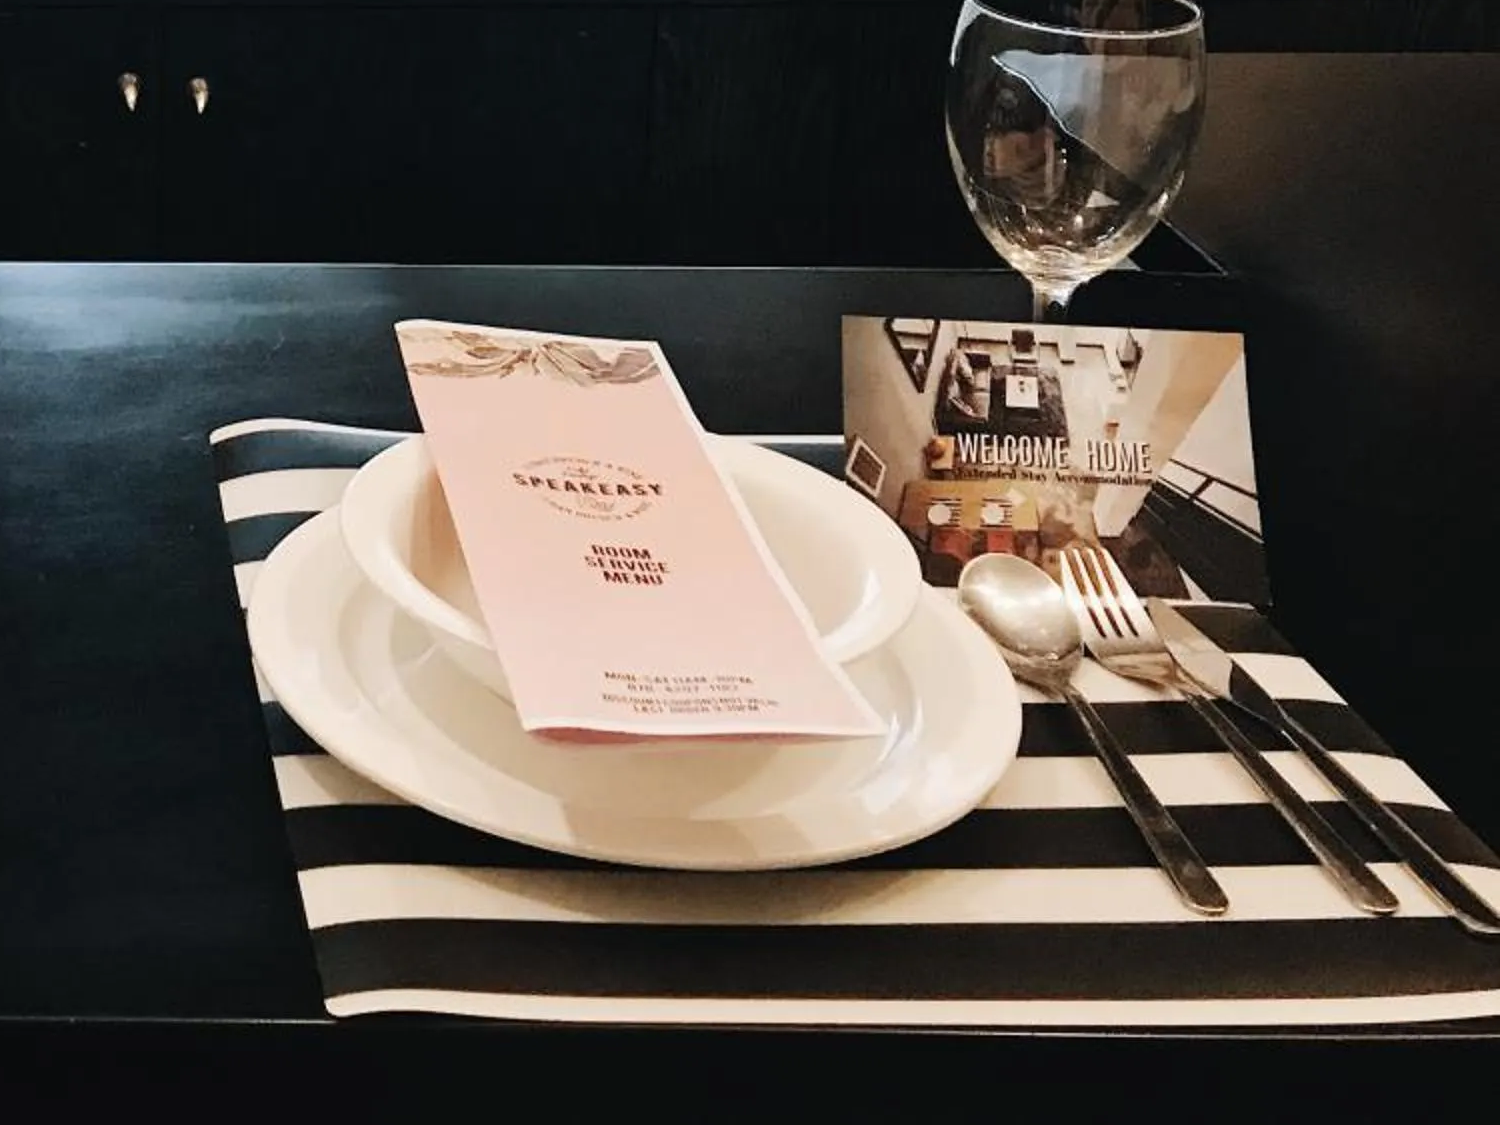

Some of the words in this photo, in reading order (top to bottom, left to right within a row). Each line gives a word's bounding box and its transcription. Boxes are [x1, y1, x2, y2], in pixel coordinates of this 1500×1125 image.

[956, 432, 1070, 470] WELCOME
[1086, 437, 1153, 474] HOME
[512, 472, 662, 496] SPEAKEASY
[590, 543, 651, 559] ROOM
[583, 555, 670, 573] SERVICE
[602, 571, 663, 586] MENU
